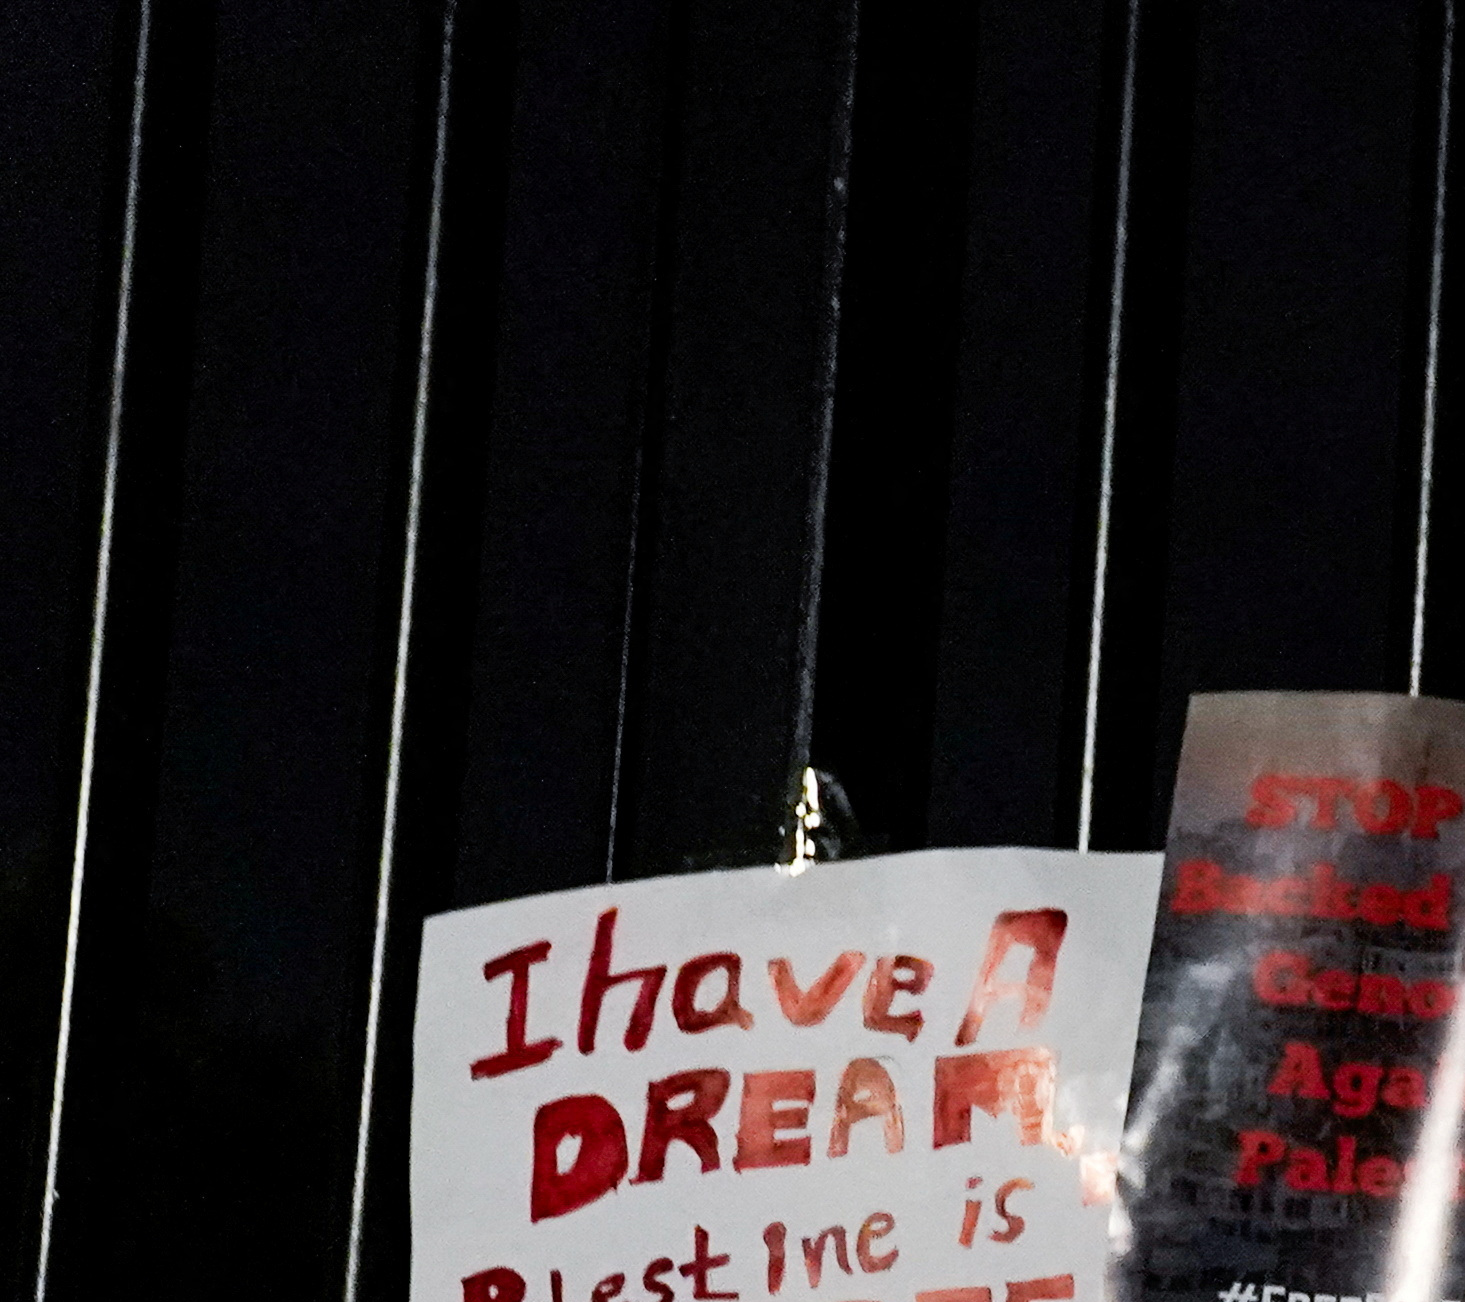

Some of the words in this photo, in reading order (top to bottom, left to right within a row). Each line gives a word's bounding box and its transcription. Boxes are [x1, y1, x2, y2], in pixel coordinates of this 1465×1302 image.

[1244, 773, 1465, 839] STOP
[470, 941, 566, 1081] I
[580, 904, 936, 1055] have
[955, 908, 1071, 1047] A
[529, 1046, 1060, 1224] DREAM
[957, 1176, 1027, 1249] is
